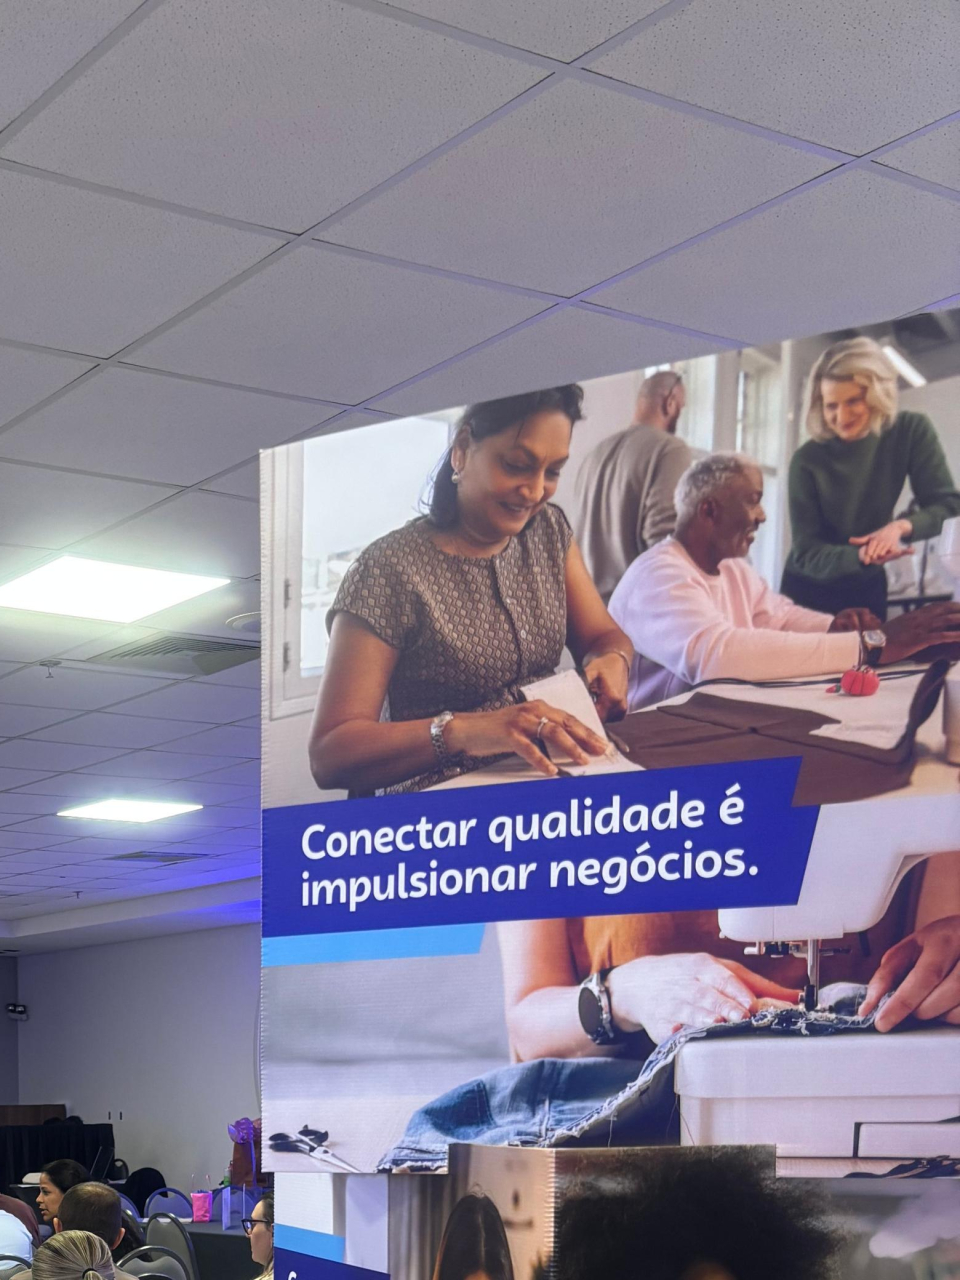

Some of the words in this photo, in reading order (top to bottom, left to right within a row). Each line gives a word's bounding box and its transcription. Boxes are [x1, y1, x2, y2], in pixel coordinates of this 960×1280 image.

[301, 816, 478, 861] Conectar
[487, 790, 706, 852] qualidade
[720, 783, 745, 826] é
[301, 859, 537, 912] impulsionar
[548, 841, 759, 895] negócios.
